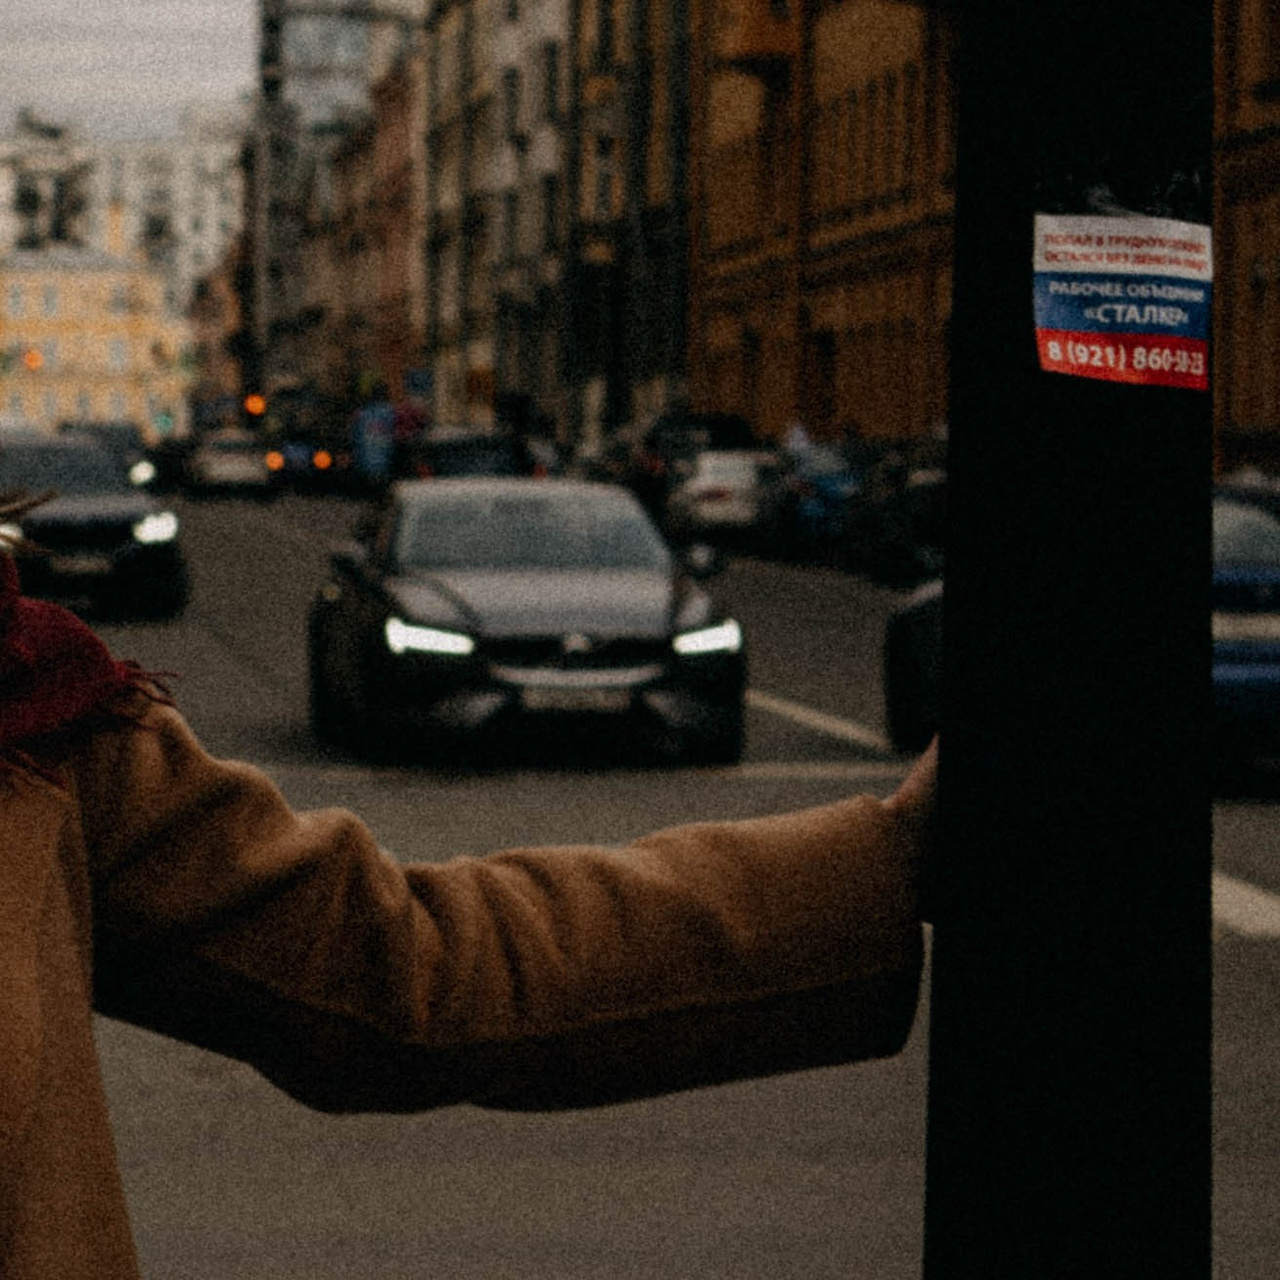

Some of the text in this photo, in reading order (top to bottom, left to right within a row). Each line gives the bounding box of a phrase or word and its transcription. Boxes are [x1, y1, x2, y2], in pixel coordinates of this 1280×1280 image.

[1048, 280, 1124, 297] РАБОЧЕЕ
[1047, 340, 1063, 361] 8
[1067, 340, 1127, 371] (921)
